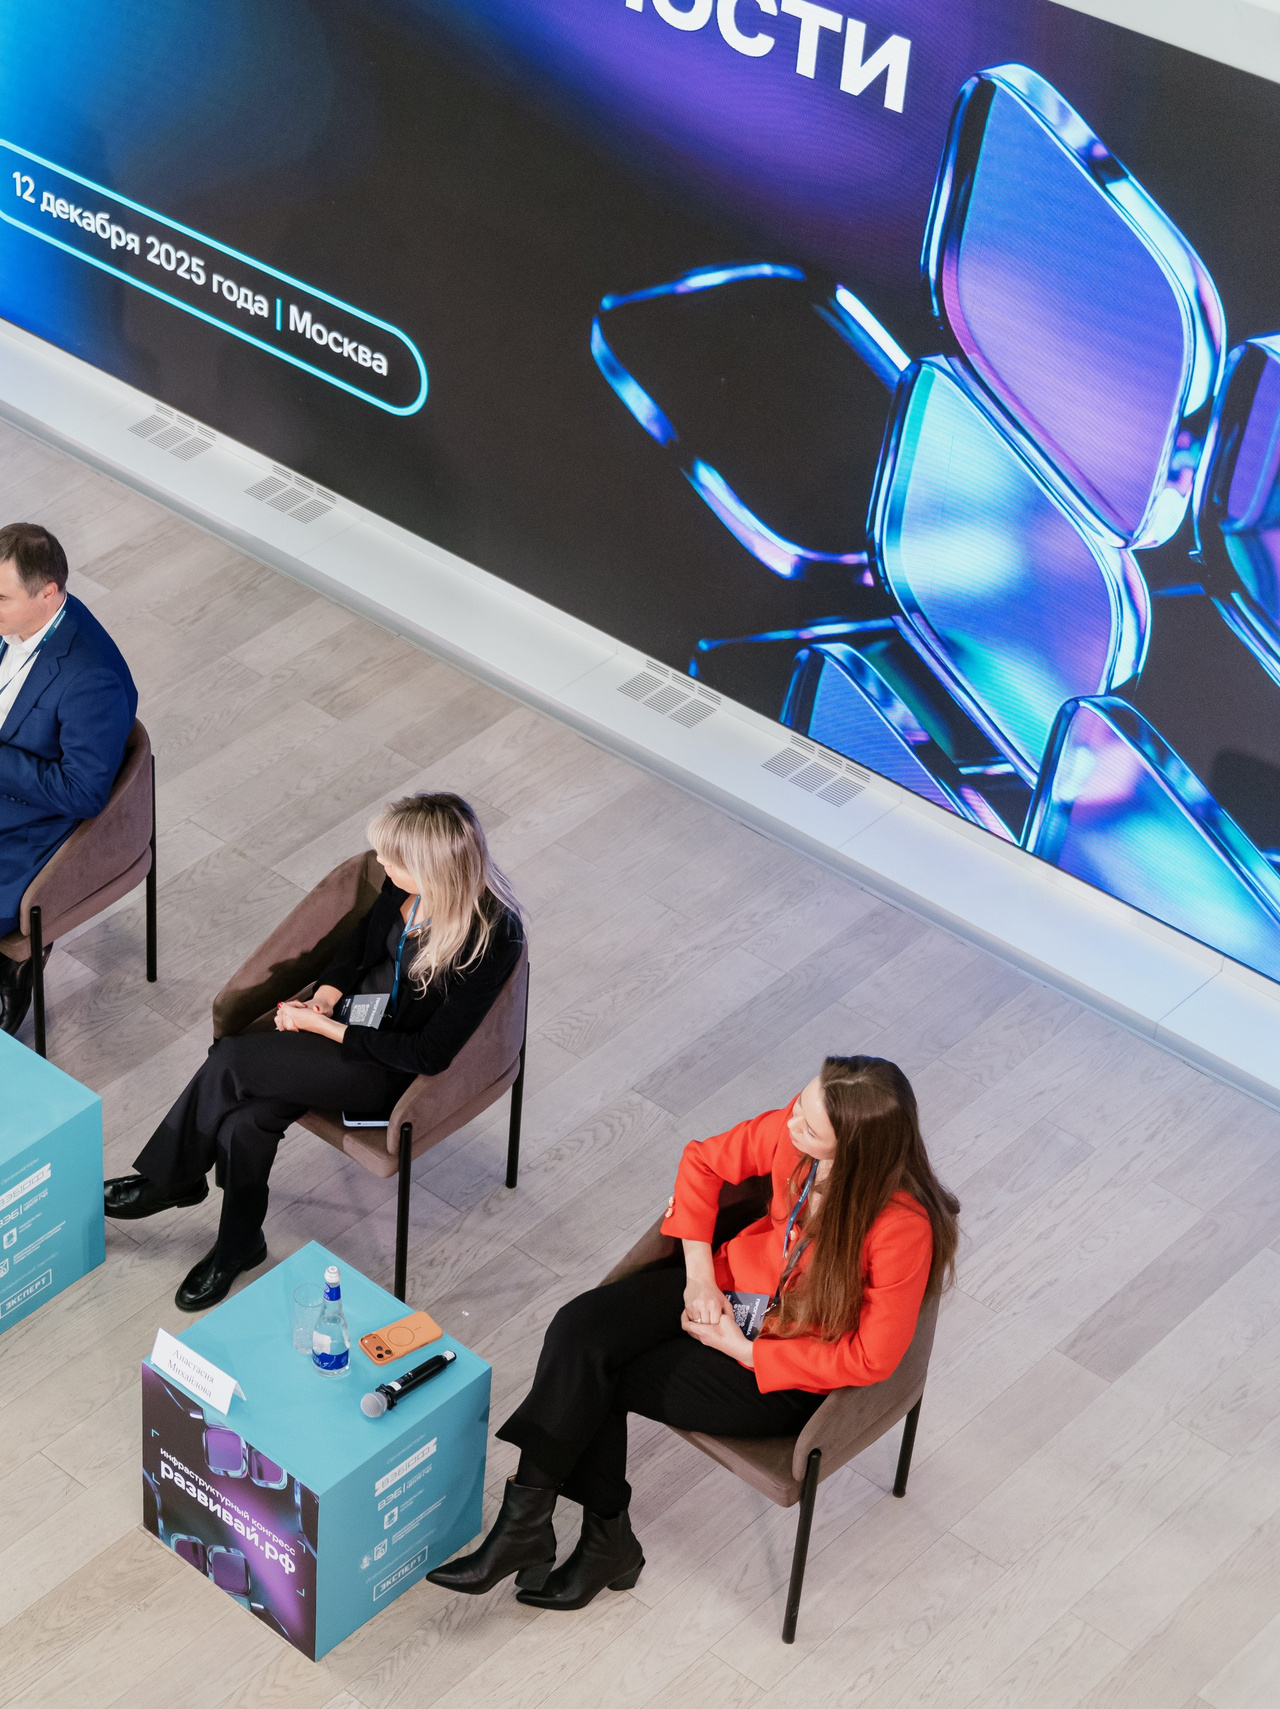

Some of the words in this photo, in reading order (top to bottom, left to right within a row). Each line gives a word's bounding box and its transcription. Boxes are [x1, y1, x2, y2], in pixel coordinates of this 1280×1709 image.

[12, 171, 36, 204] 12
[40, 190, 140, 256] декабря
[145, 236, 206, 285] 2025
[211, 273, 269, 318] года
[289, 304, 389, 376] Москва
[5, 1276, 47, 1311] ЭКСПЕРТ
[167, 1359, 212, 1398] Михайлова
[172, 1349, 215, 1384] Анастасия
[160, 1447, 250, 1520] инфраструктурный
[251, 1518, 296, 1556] конгресс
[160, 1460, 296, 1575] развивай.рф
[377, 1486, 402, 1511] ВЭБ
[380, 1554, 423, 1592] ЭКСПЕРТ
